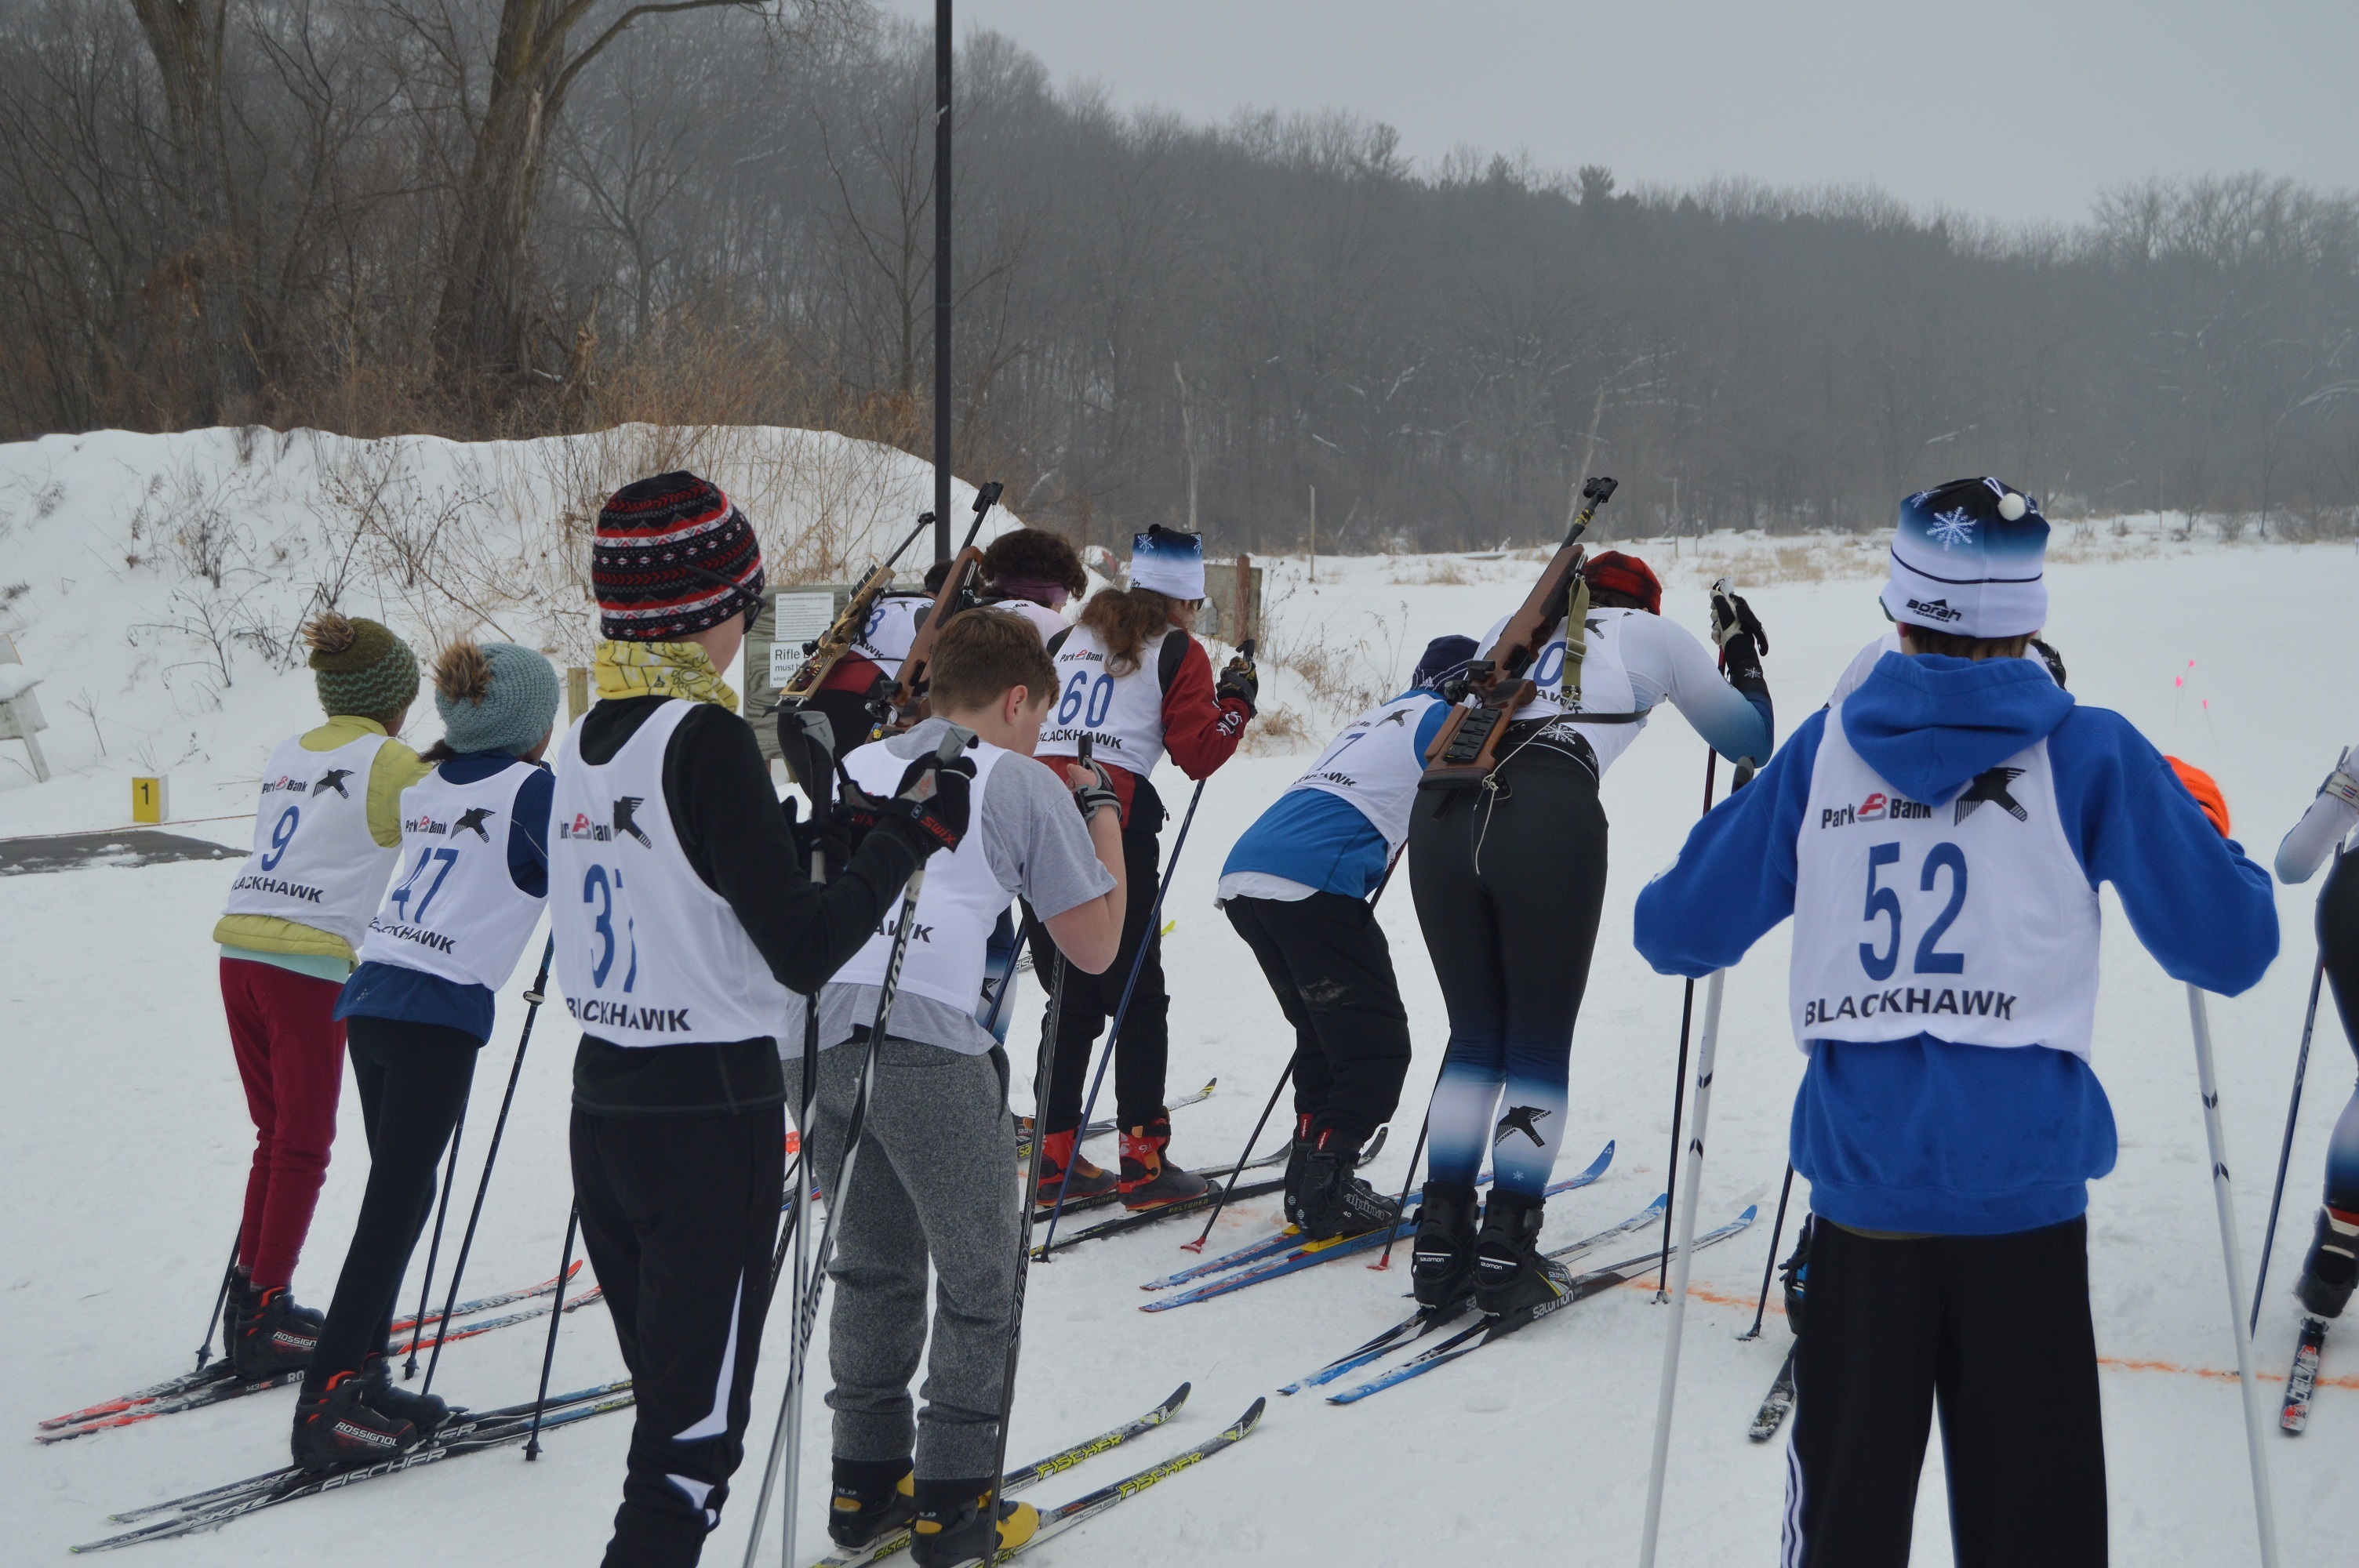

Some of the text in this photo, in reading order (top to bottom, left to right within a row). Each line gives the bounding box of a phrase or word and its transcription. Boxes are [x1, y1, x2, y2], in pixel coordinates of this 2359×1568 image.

[775, 648, 800, 660] Rifle
[1060, 652, 1103, 662] Park Bank
[1057, 670, 1114, 728] 60
[141, 782, 148, 805] 1
[286, 779, 307, 793] Bank
[405, 819, 447, 834] Park Bank
[1821, 798, 1932, 829] Park Bank
[261, 805, 300, 872] 9
[231, 876, 324, 903] LACKHAWK
[391, 848, 459, 924] 47
[1859, 841, 1968, 982] 52
[566, 997, 692, 1032] BCKHAWK
[1805, 988, 2017, 1027] BLACKHAWK
[1540, 1110, 1552, 1119] TEAM
[1075, 1194, 1117, 1210] PELTONEN
[1169, 1199, 1208, 1213] PELTONEN
[1344, 1193, 1385, 1221] alpina
[1350, 1232, 1391, 1250] FISCHE
[1481, 1261, 1503, 1270] salomon
[1548, 1271, 1567, 1279] salomon
[1533, 1290, 1574, 1319] salomon
[273, 1330, 317, 1347] ROSSIGN
[335, 1421, 398, 1446] ROSSIGNOL
[322, 1448, 447, 1492] FISCHER
[1035, 1435, 1123, 1480] FISCHER
[1118, 1452, 1204, 1499] FISCHER
[872, 1535, 911, 1562] FISCH
